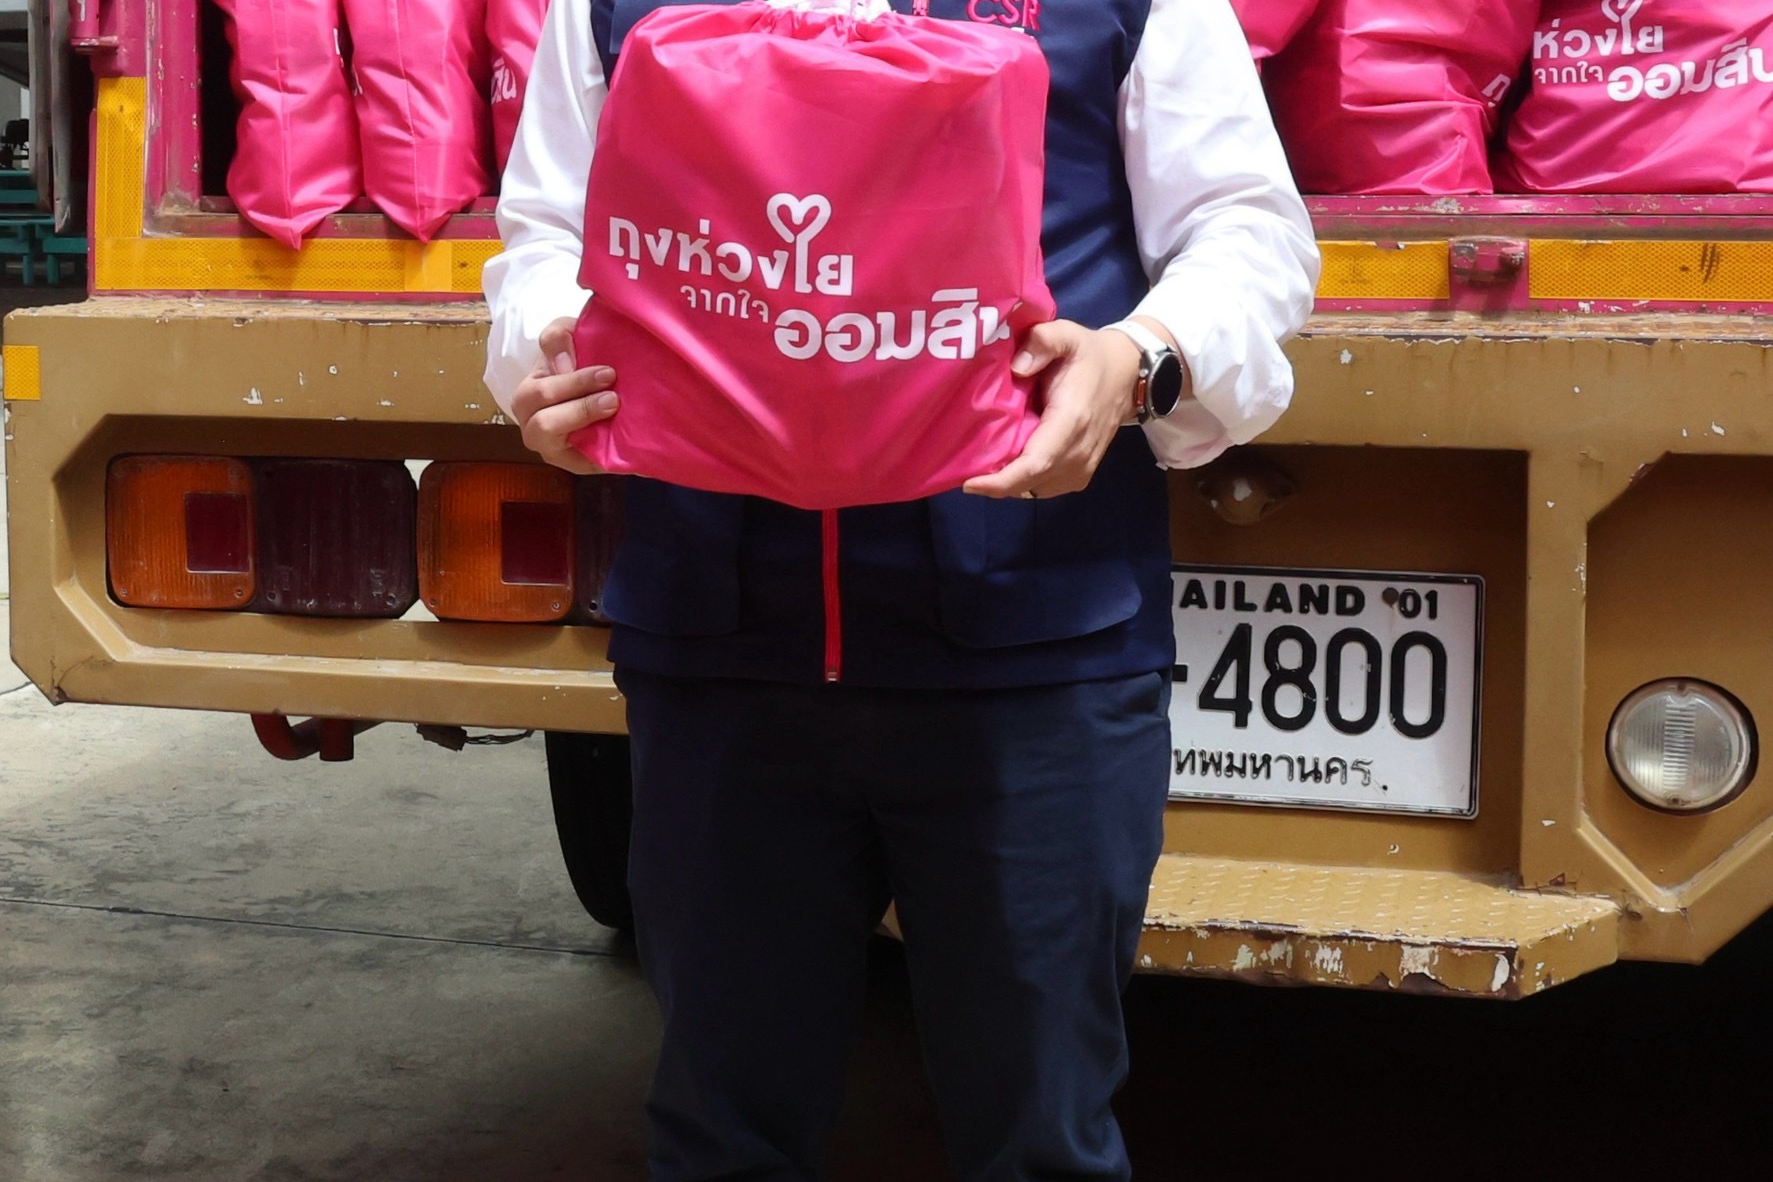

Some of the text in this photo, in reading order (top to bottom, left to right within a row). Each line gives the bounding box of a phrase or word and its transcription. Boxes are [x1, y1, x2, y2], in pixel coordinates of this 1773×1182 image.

[1534, 60, 1604, 85] จากใจ
[607, 192, 854, 297] ถุงห่วงใย
[680, 284, 770, 324] จากใจ
[1170, 578, 1366, 617] AILAND
